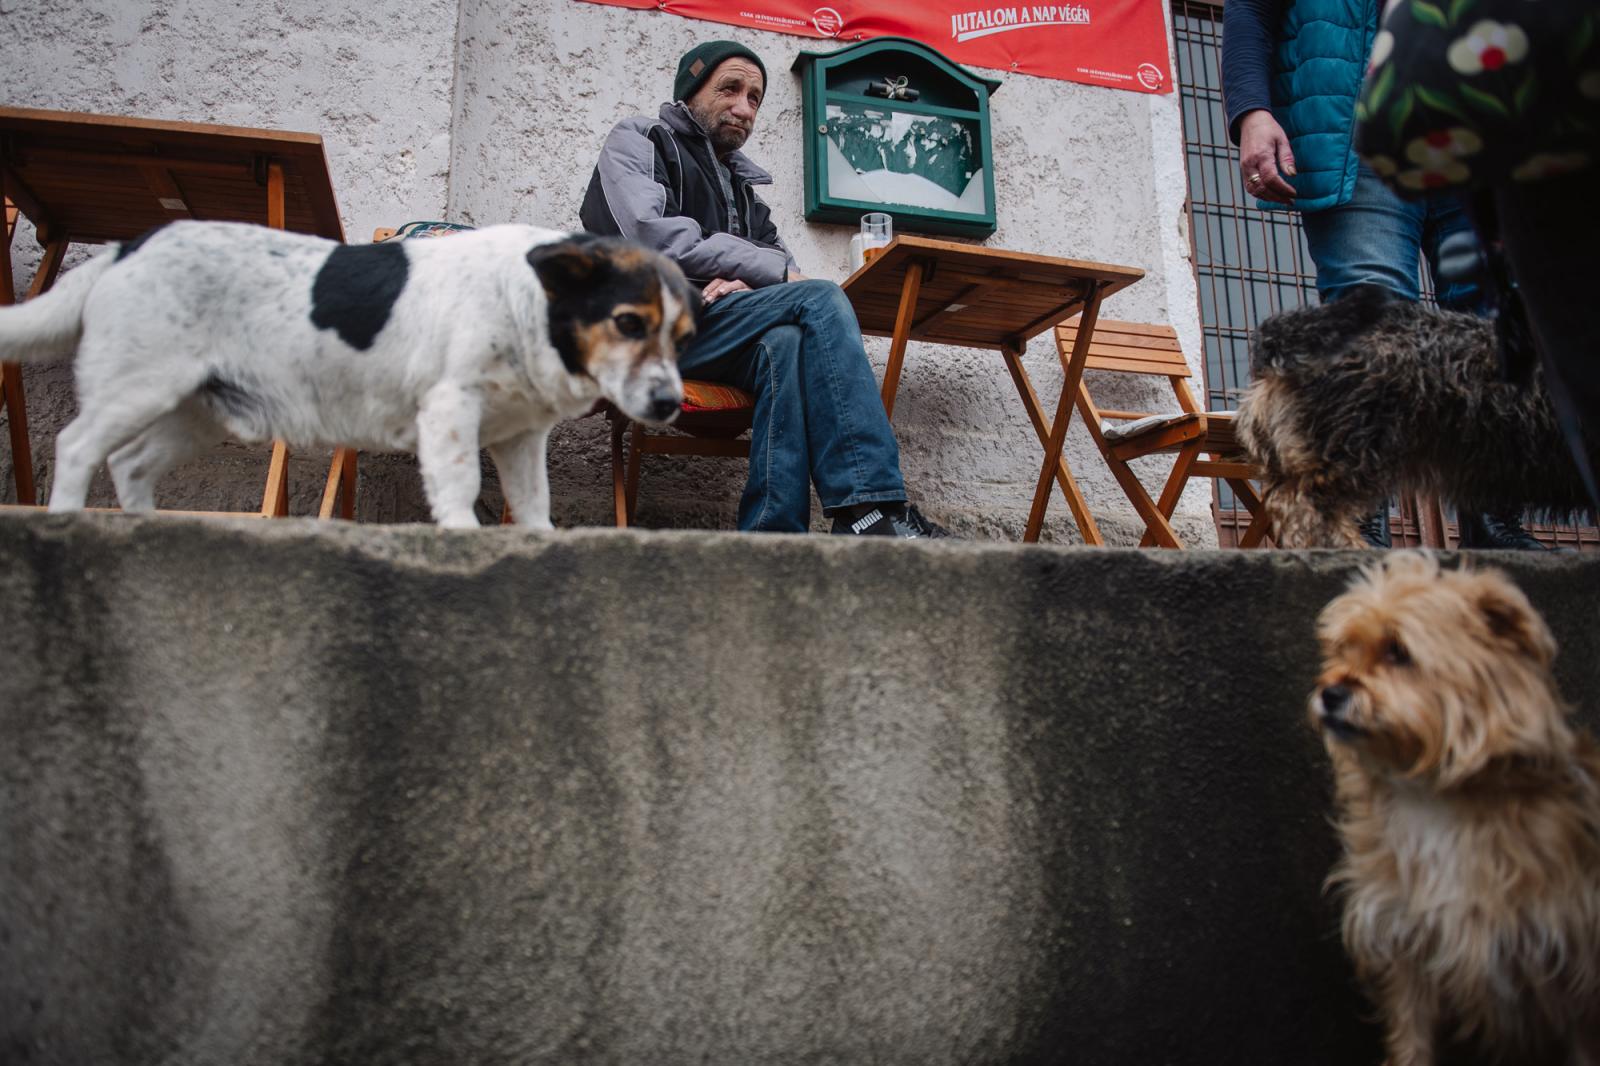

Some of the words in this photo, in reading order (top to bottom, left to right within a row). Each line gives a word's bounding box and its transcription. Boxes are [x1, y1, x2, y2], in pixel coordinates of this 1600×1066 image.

[951, 7, 1018, 38] JUTALOM
[1020, 6, 1031, 23] A
[1032, 6, 1057, 22] NAP
[1058, 3, 1090, 23] VÉGÉN
[851, 508, 883, 535] PUMA
